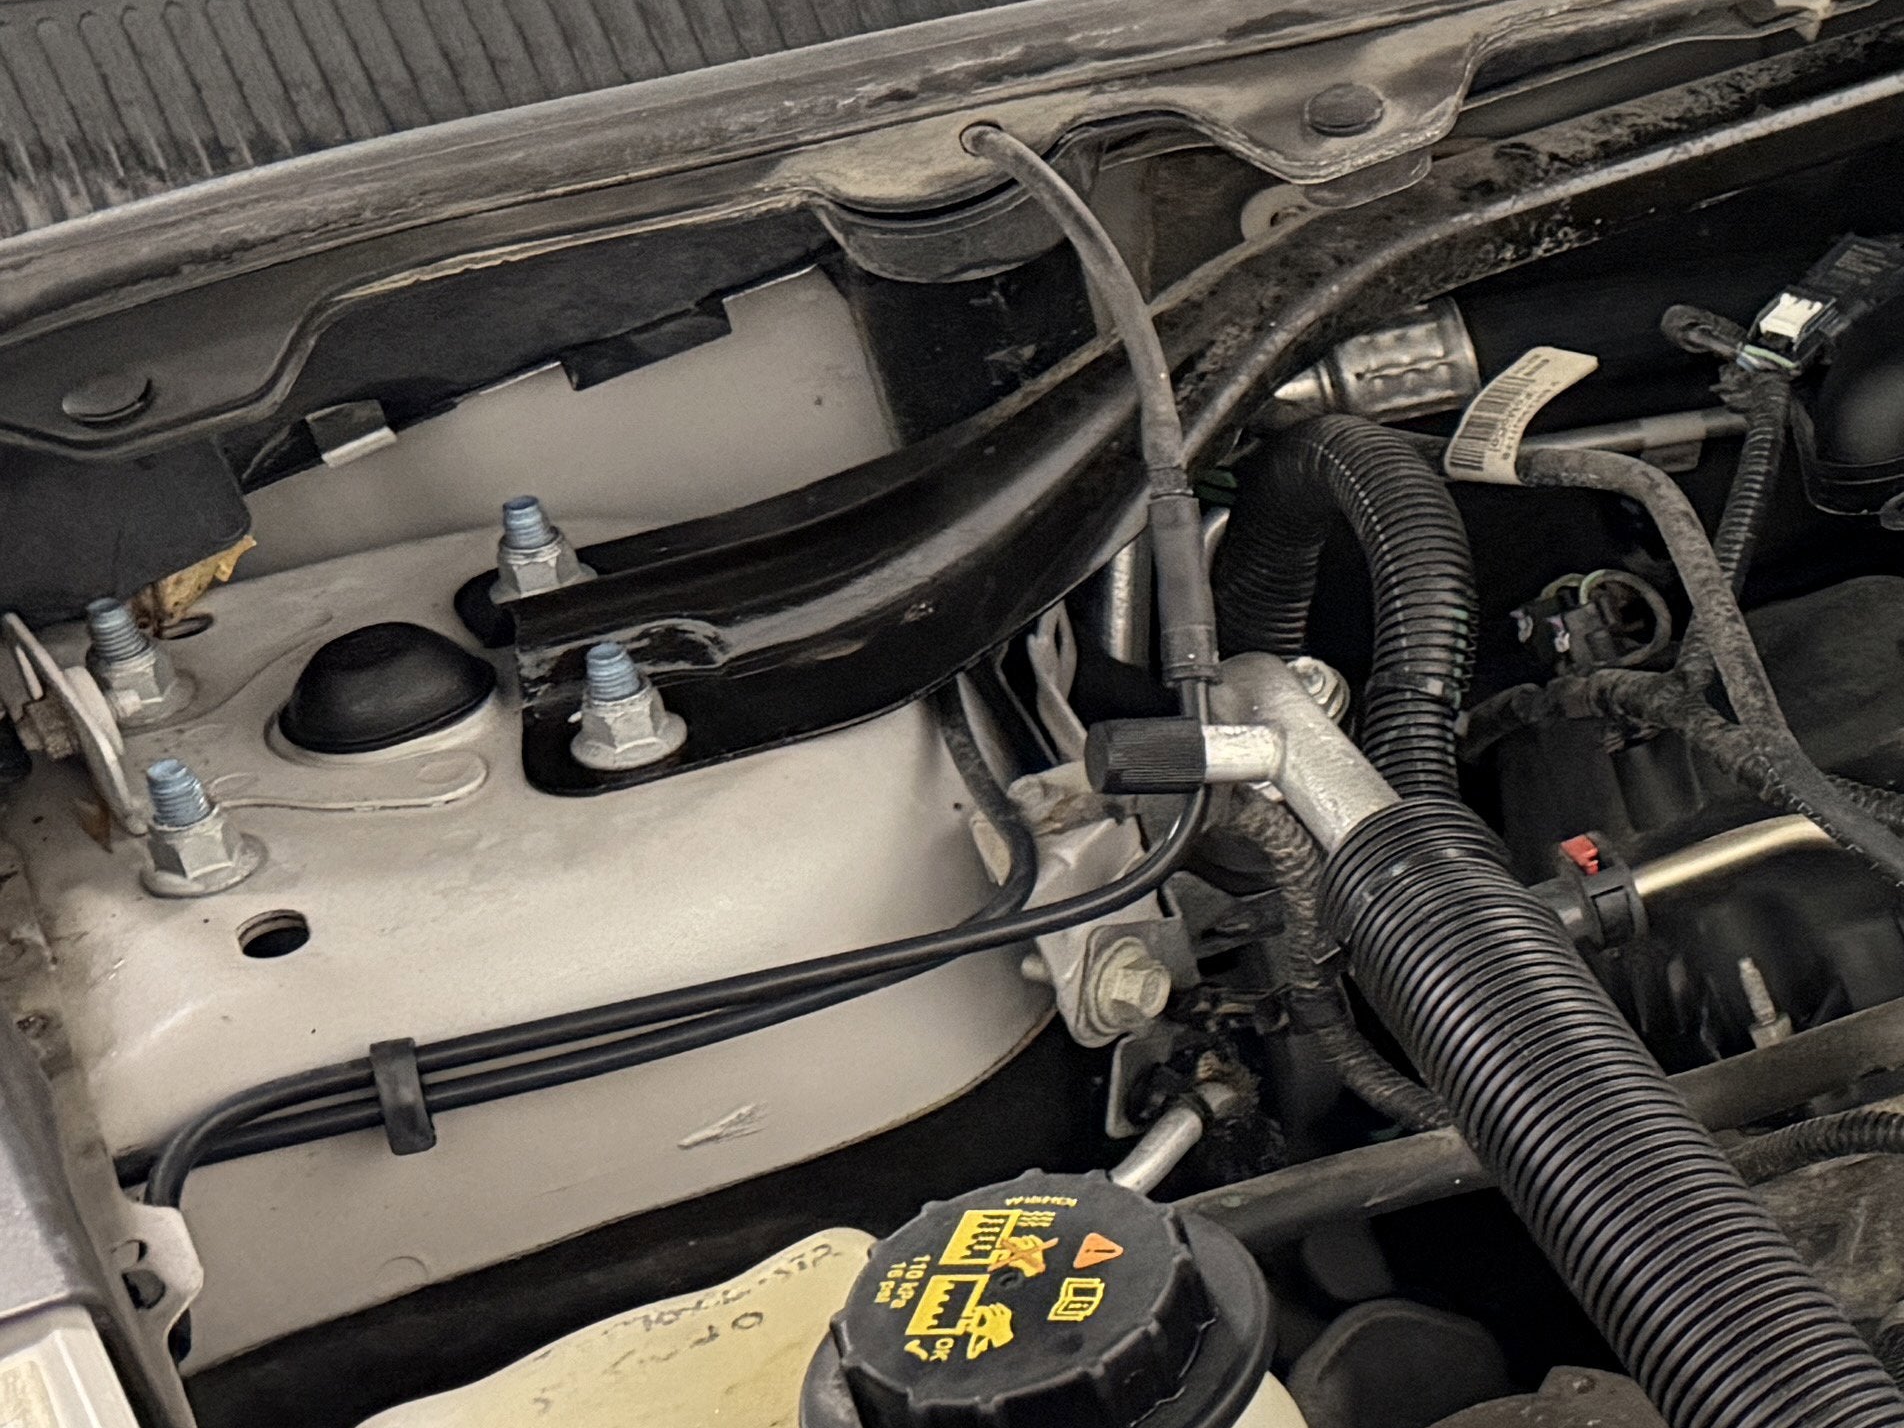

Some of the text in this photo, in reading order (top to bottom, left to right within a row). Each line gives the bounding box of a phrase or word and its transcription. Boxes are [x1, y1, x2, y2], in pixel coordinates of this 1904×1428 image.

[888, 1255, 931, 1310] 110 kPa
[928, 1338, 955, 1362] OK
